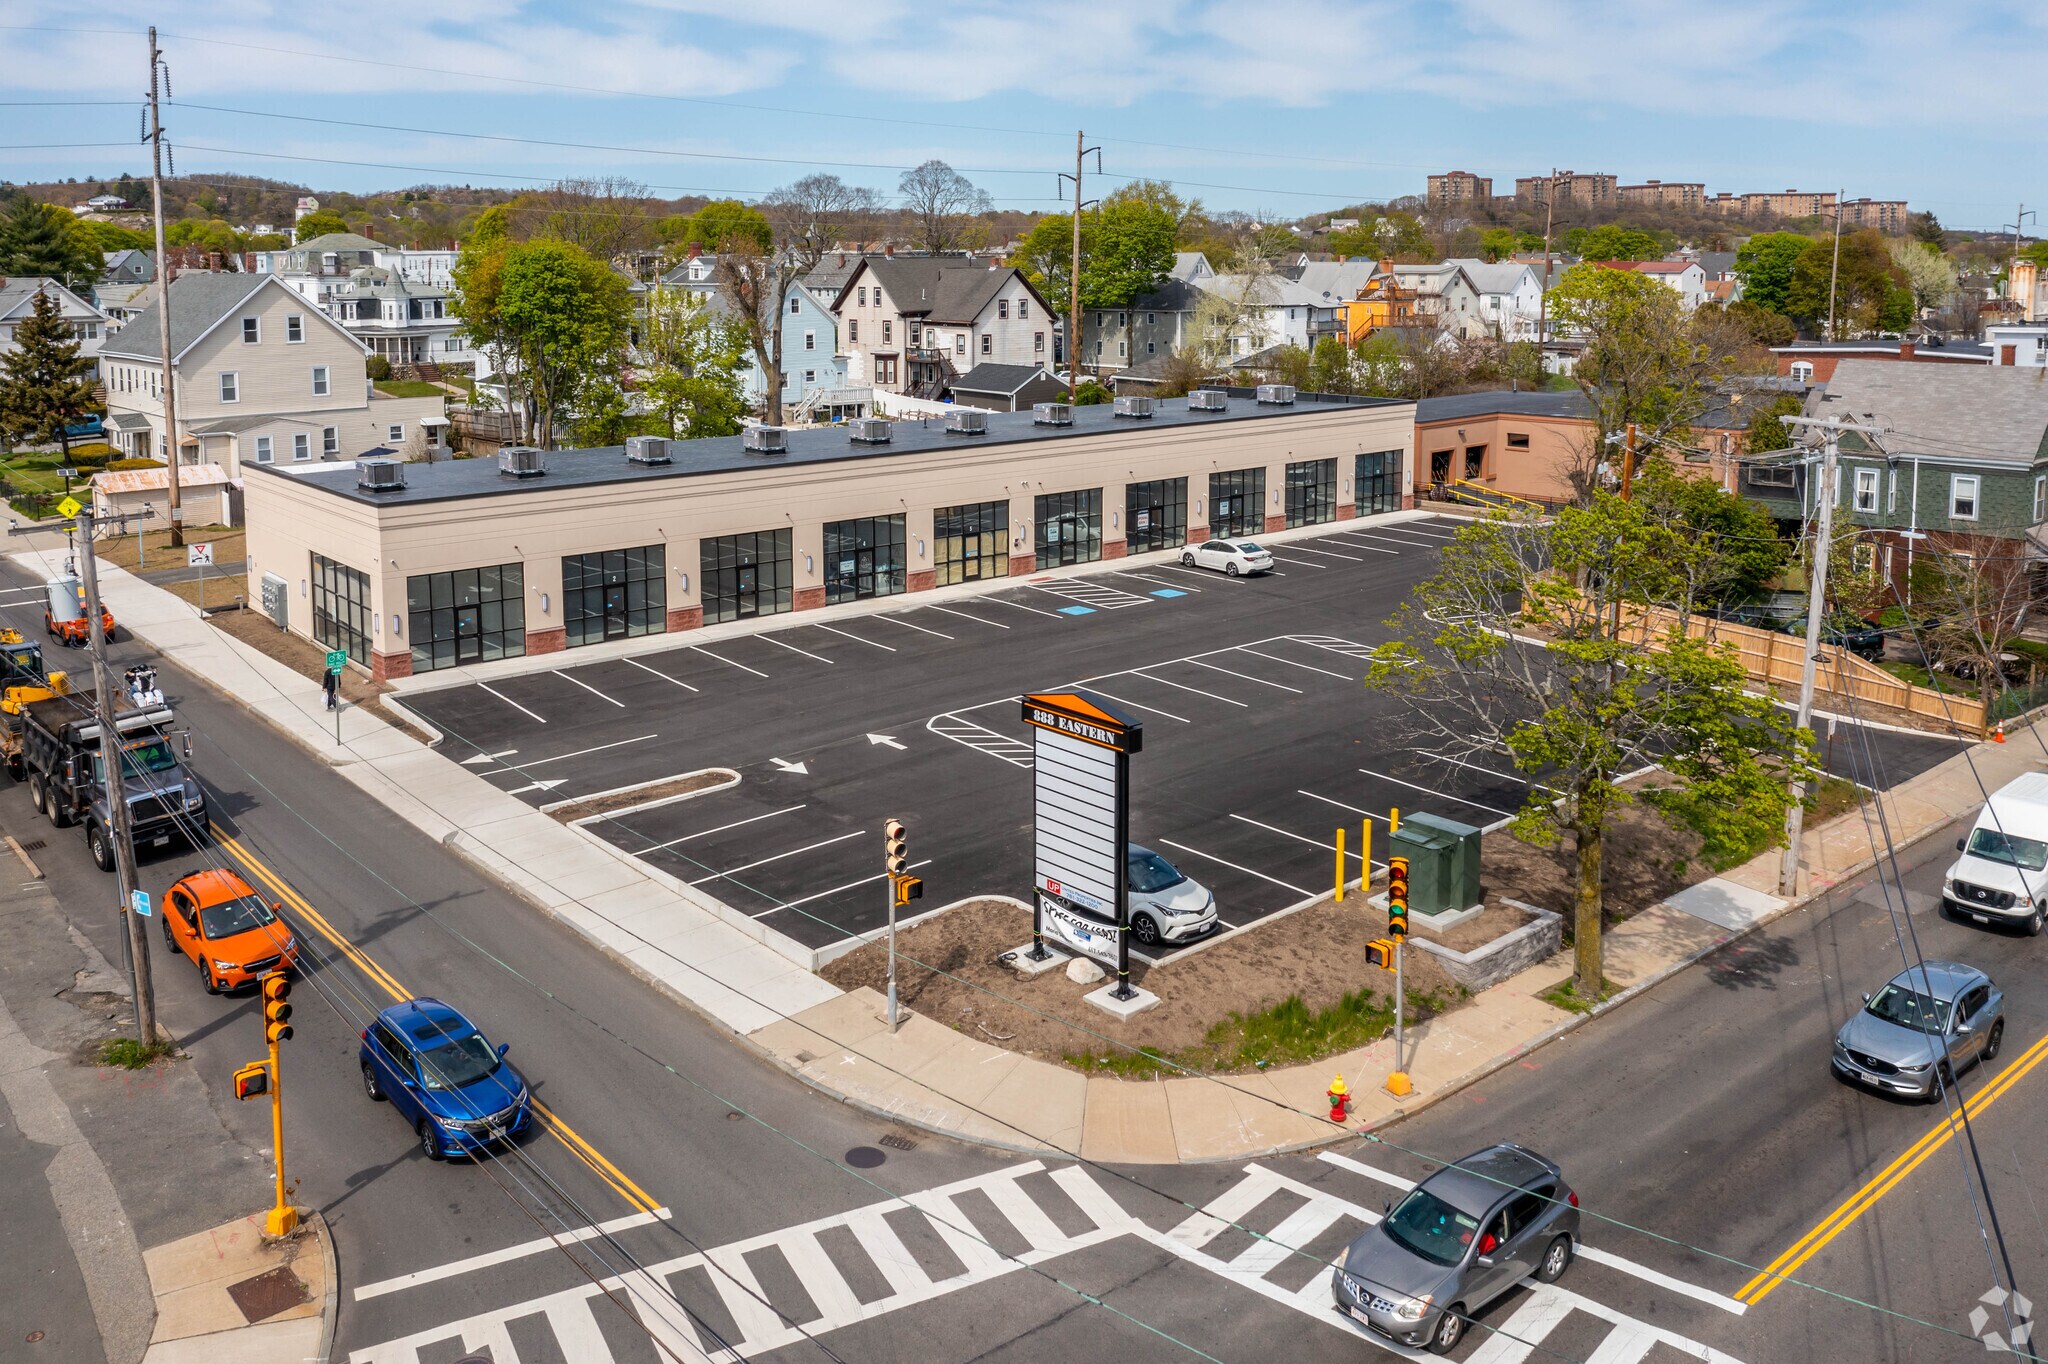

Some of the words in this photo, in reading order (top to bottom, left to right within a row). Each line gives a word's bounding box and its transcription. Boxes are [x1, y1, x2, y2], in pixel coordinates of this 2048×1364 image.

[1033, 709, 1055, 726] 888
[1058, 716, 1115, 745] EASTERN
[1048, 881, 1060, 892] UP
